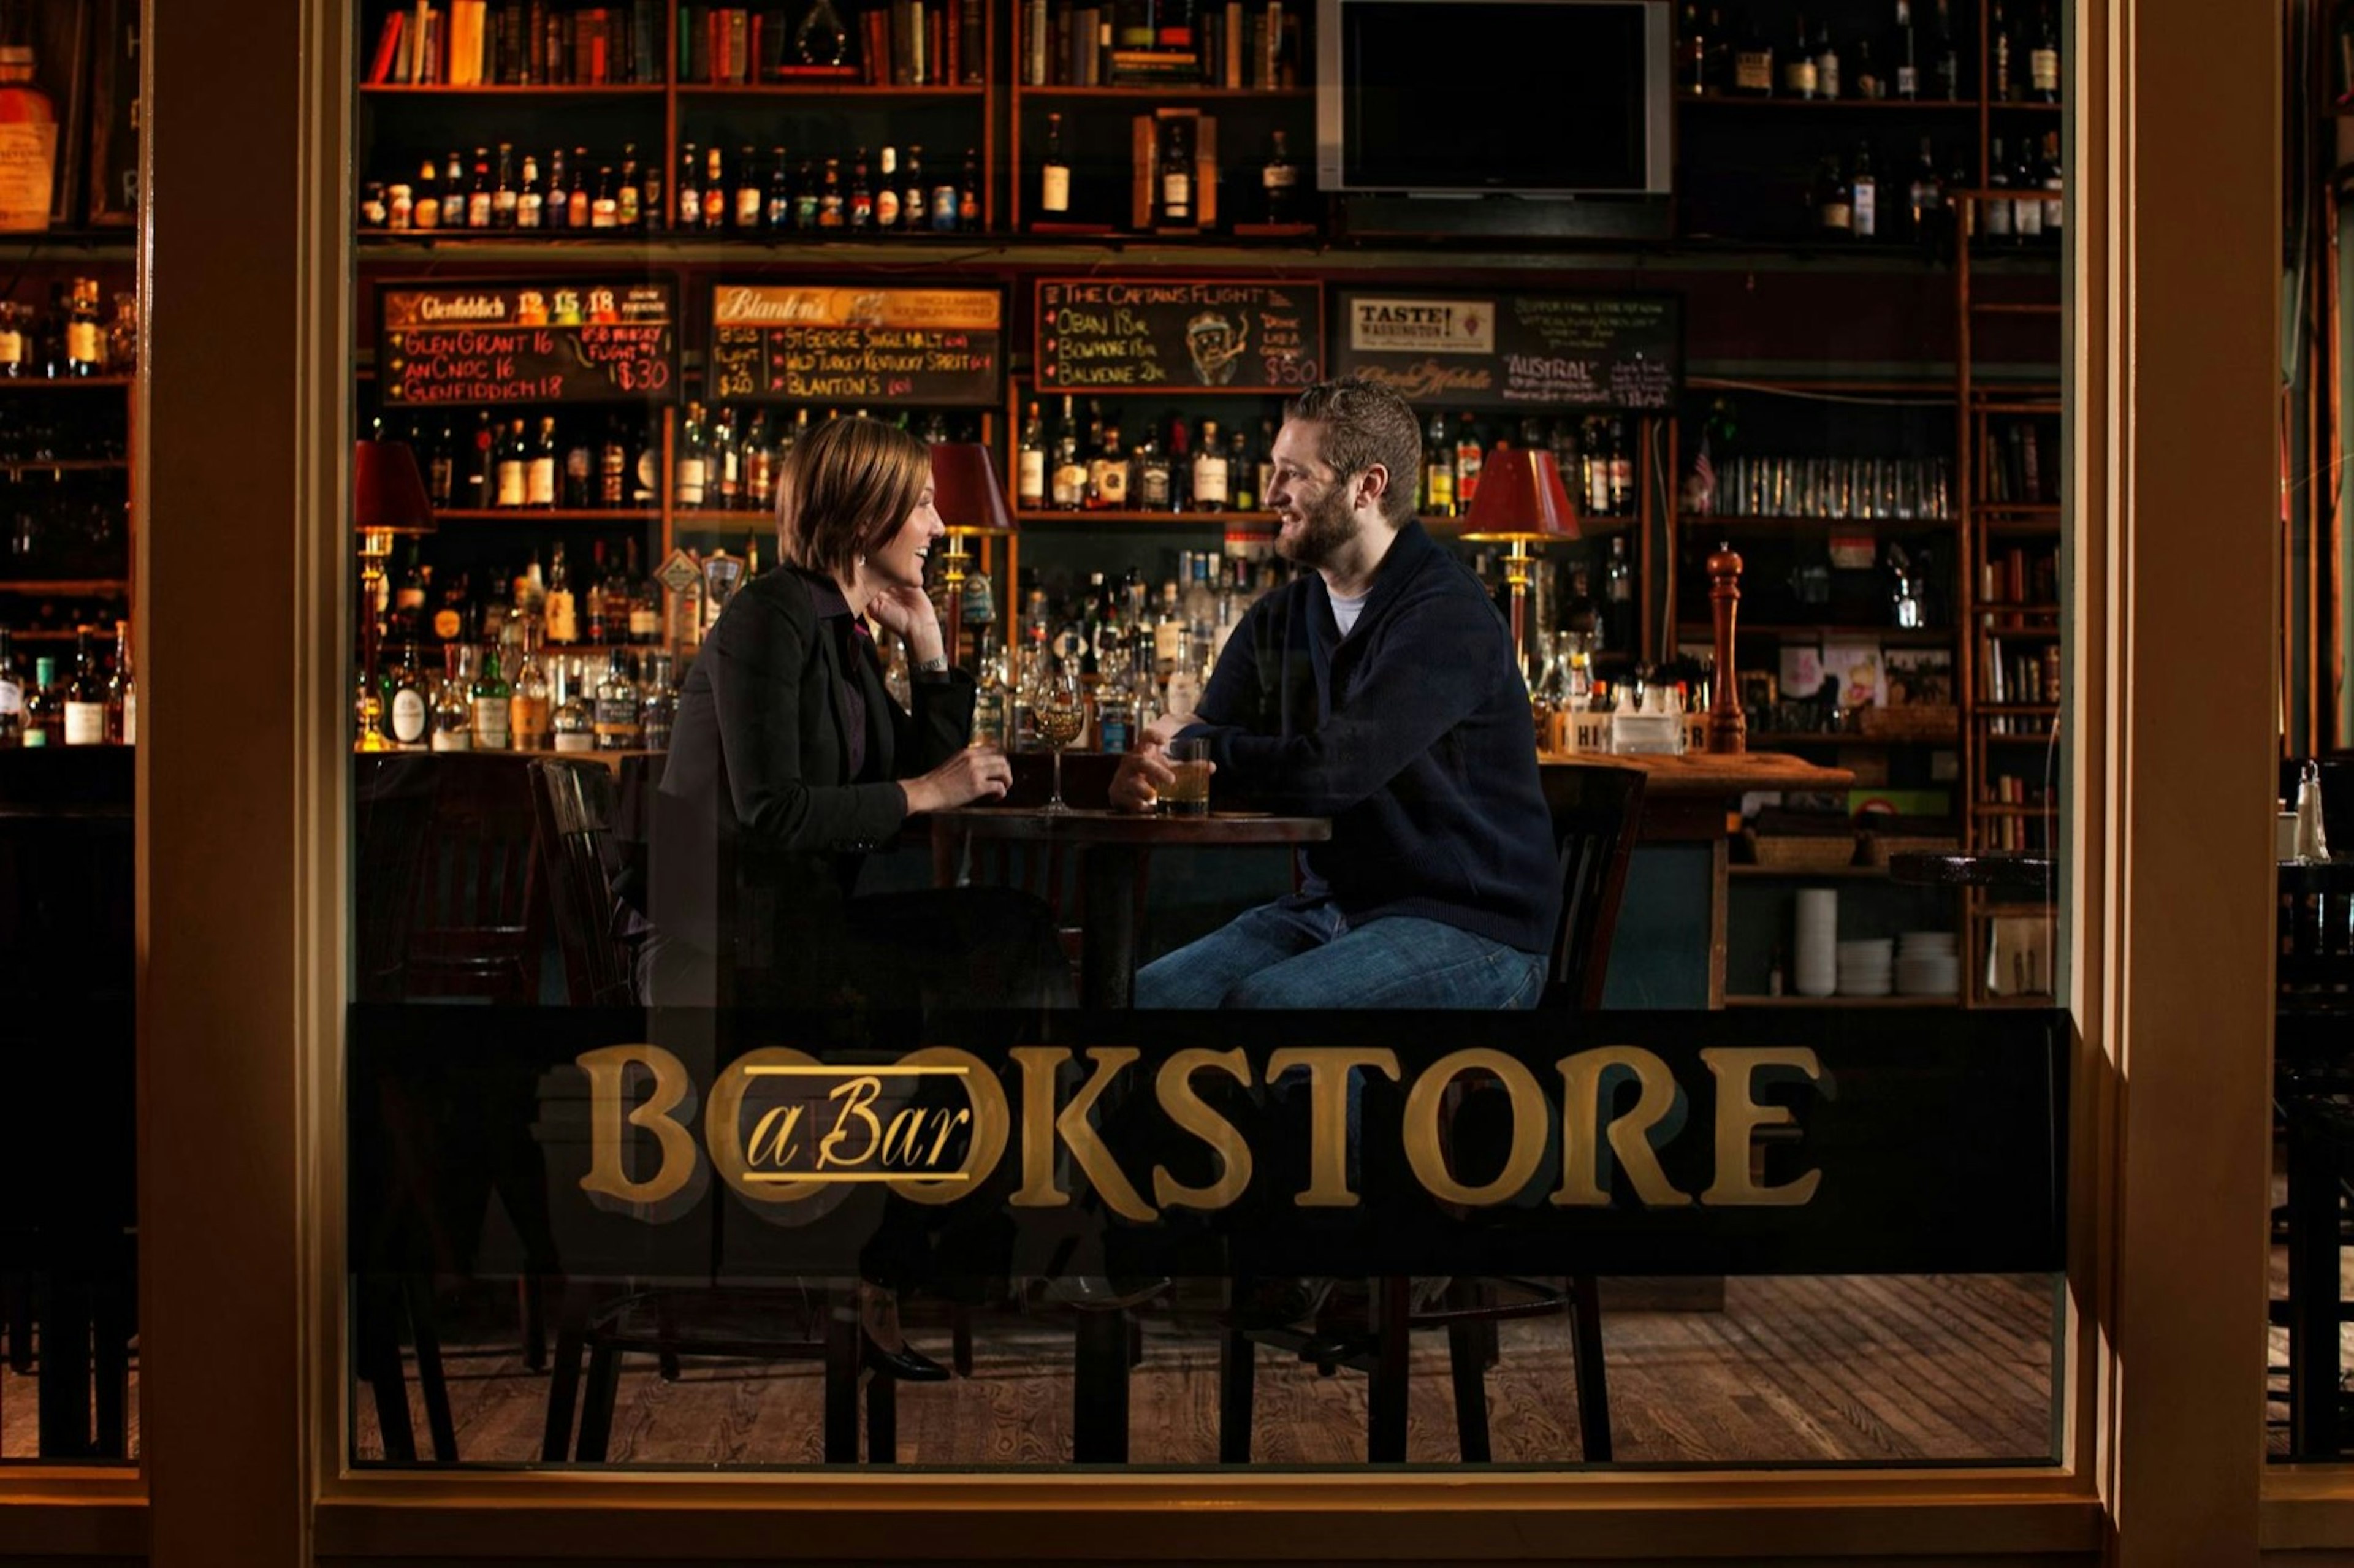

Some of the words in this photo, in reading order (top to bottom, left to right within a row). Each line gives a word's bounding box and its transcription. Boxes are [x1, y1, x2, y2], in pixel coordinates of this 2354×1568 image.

[421, 295, 506, 321] Glenfiddich
[518, 291, 544, 313] 12
[554, 291, 580, 314] 15
[589, 290, 614, 313] 18
[715, 287, 825, 321] Blanton's
[1063, 285, 1103, 305] THE
[1057, 307, 1109, 336] OBAN
[1358, 305, 1451, 336] TASTE!
[533, 330, 554, 356] 16
[905, 330, 943, 349] MALT
[495, 356, 516, 381] 16
[617, 359, 670, 392] $30
[1265, 356, 1318, 386] $50
[403, 378, 536, 402] GLENFIDDICH
[540, 375, 564, 398] 18
[718, 373, 755, 397] $20
[786, 371, 881, 397] BLANTON'S
[574, 1045, 1823, 1222] BOOKSTORE
[744, 1103, 804, 1168] a
[815, 1075, 969, 1171] Bar
